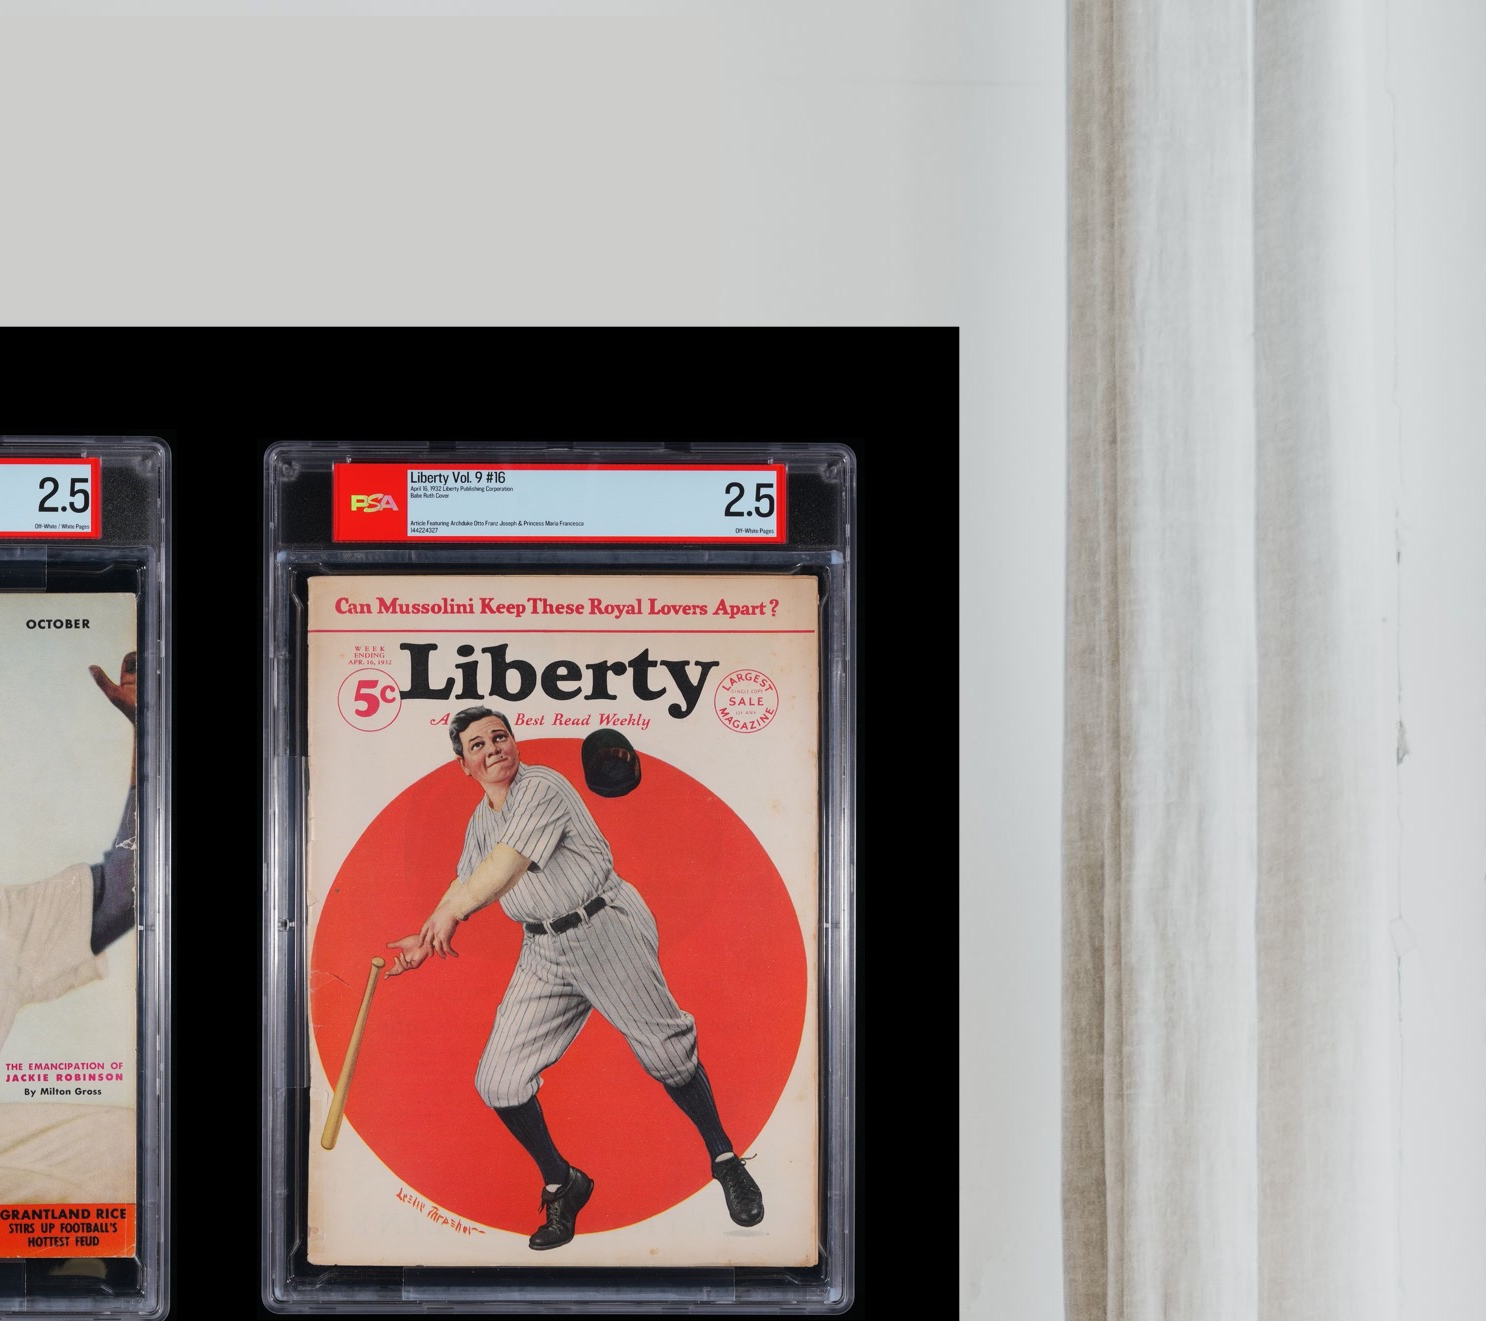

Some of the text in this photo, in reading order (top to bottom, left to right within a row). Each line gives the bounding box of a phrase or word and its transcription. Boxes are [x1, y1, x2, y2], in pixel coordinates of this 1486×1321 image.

[410, 471, 506, 485] Liberty Vol. 9 #16
[38, 476, 90, 513] 2.5
[724, 482, 775, 518] 2.5
[350, 493, 399, 513] PSA
[334, 598, 373, 616] Can
[377, 597, 475, 616] Mussolini
[479, 598, 527, 619] Keep
[527, 597, 585, 616] These
[588, 598, 643, 618] Royal
[647, 598, 707, 617] Lovers
[26, 618, 91, 630] OCTOBER
[399, 642, 720, 720] Liberty
[721, 672, 774, 692] LARGEST
[728, 696, 764, 707] SALE
[430, 713, 450, 727] A
[514, 713, 651, 731] Best Read Weekly
[719, 707, 775, 730] MAGAZINE
[5, 1062, 124, 1071] THE EMANCIPATION OF
[5, 1072, 124, 1083] JACKIE ROBINSON
[24, 1086, 102, 1098] By Milton Gross
[0, 1208, 127, 1221] GRANTLAND RICE
[9, 1222, 118, 1234] STIRS UP FOOTBALL'S
[28, 1236, 100, 1247] HOTTEST FEUD
